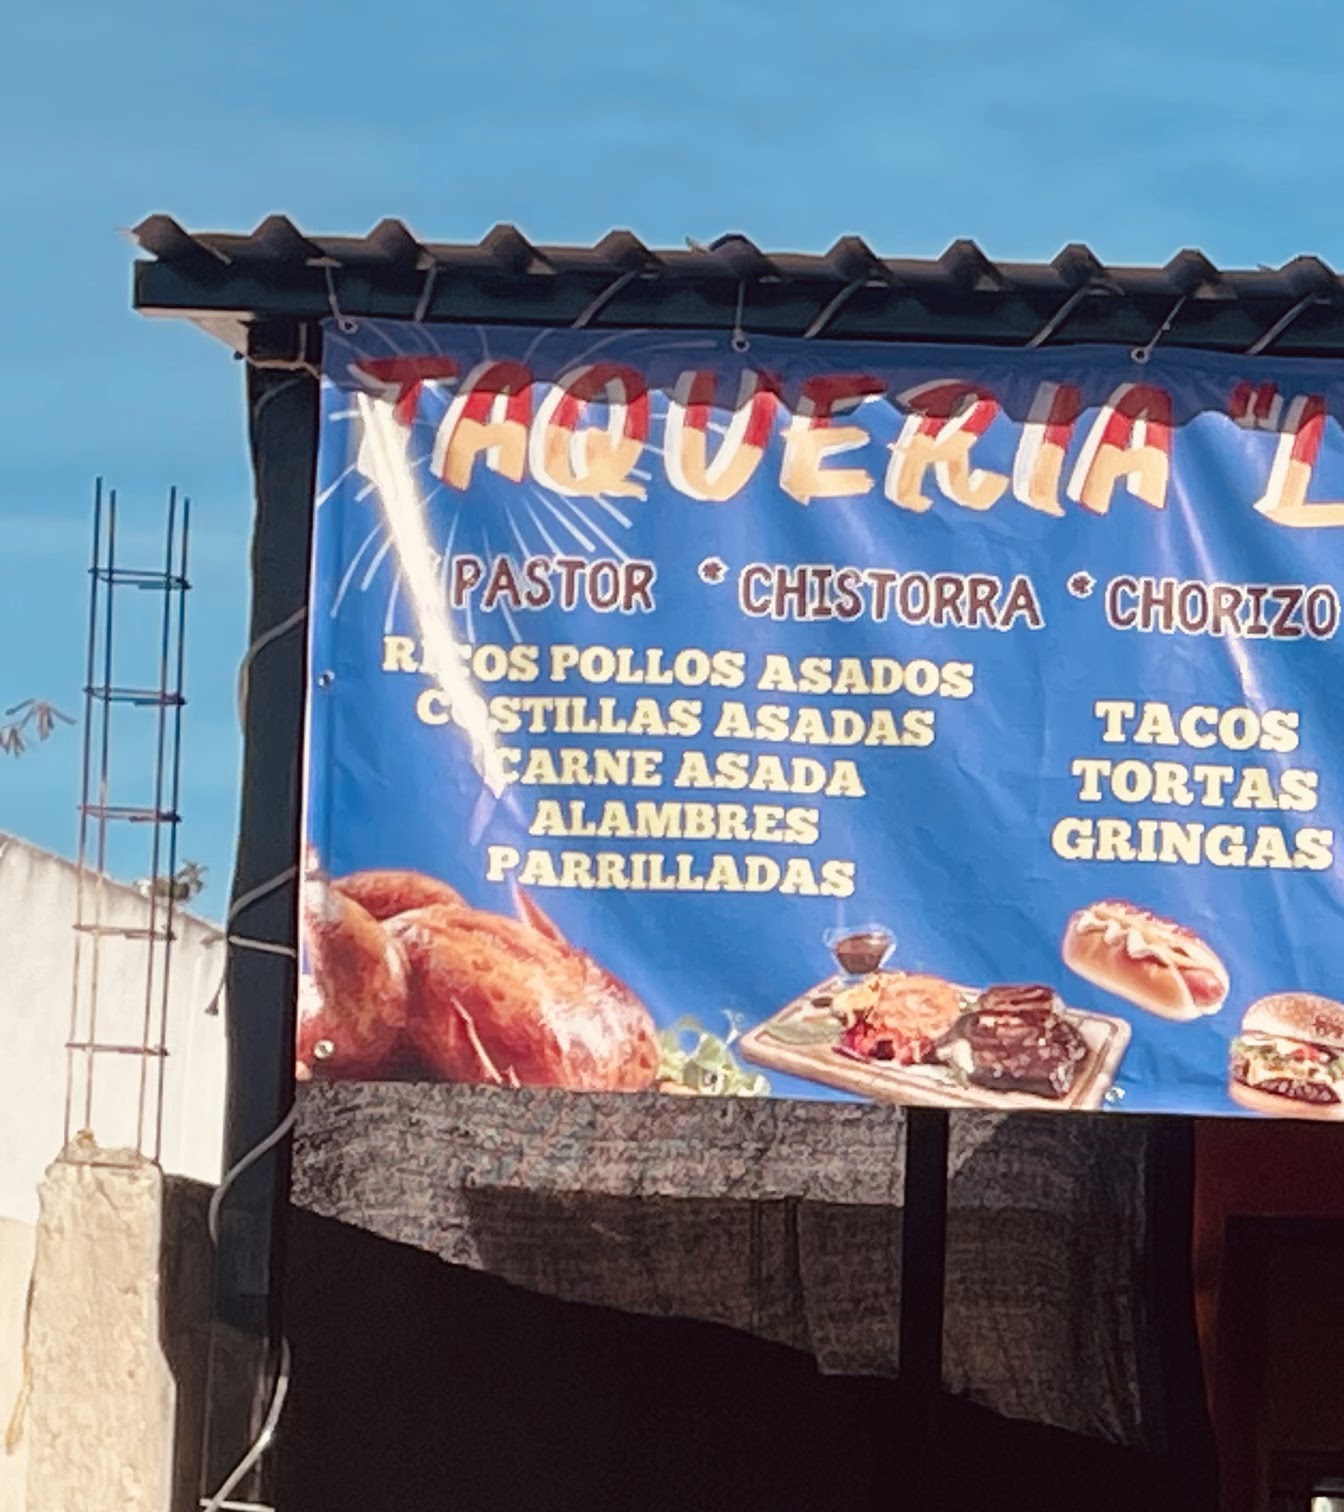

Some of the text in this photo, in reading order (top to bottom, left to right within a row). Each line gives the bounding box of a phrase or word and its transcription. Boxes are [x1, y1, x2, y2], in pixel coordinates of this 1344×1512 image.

[348, 357, 1172, 517] TAQUERIA
[451, 554, 656, 612] PASTOR
[739, 562, 1045, 629] CHISTORRA
[1106, 576, 1339, 642] CHORIZO
[382, 636, 974, 699] ROS POLLOS ASADOS
[714, 703, 935, 747] ASADAS
[1095, 701, 1300, 753] TACOS
[497, 747, 866, 797] CARNE ASADA
[1072, 759, 1320, 811] TORTAS
[529, 800, 819, 844] ALAMBRES
[1052, 819, 1334, 870] GRINGAS
[486, 846, 855, 897] PARRILLADAS
